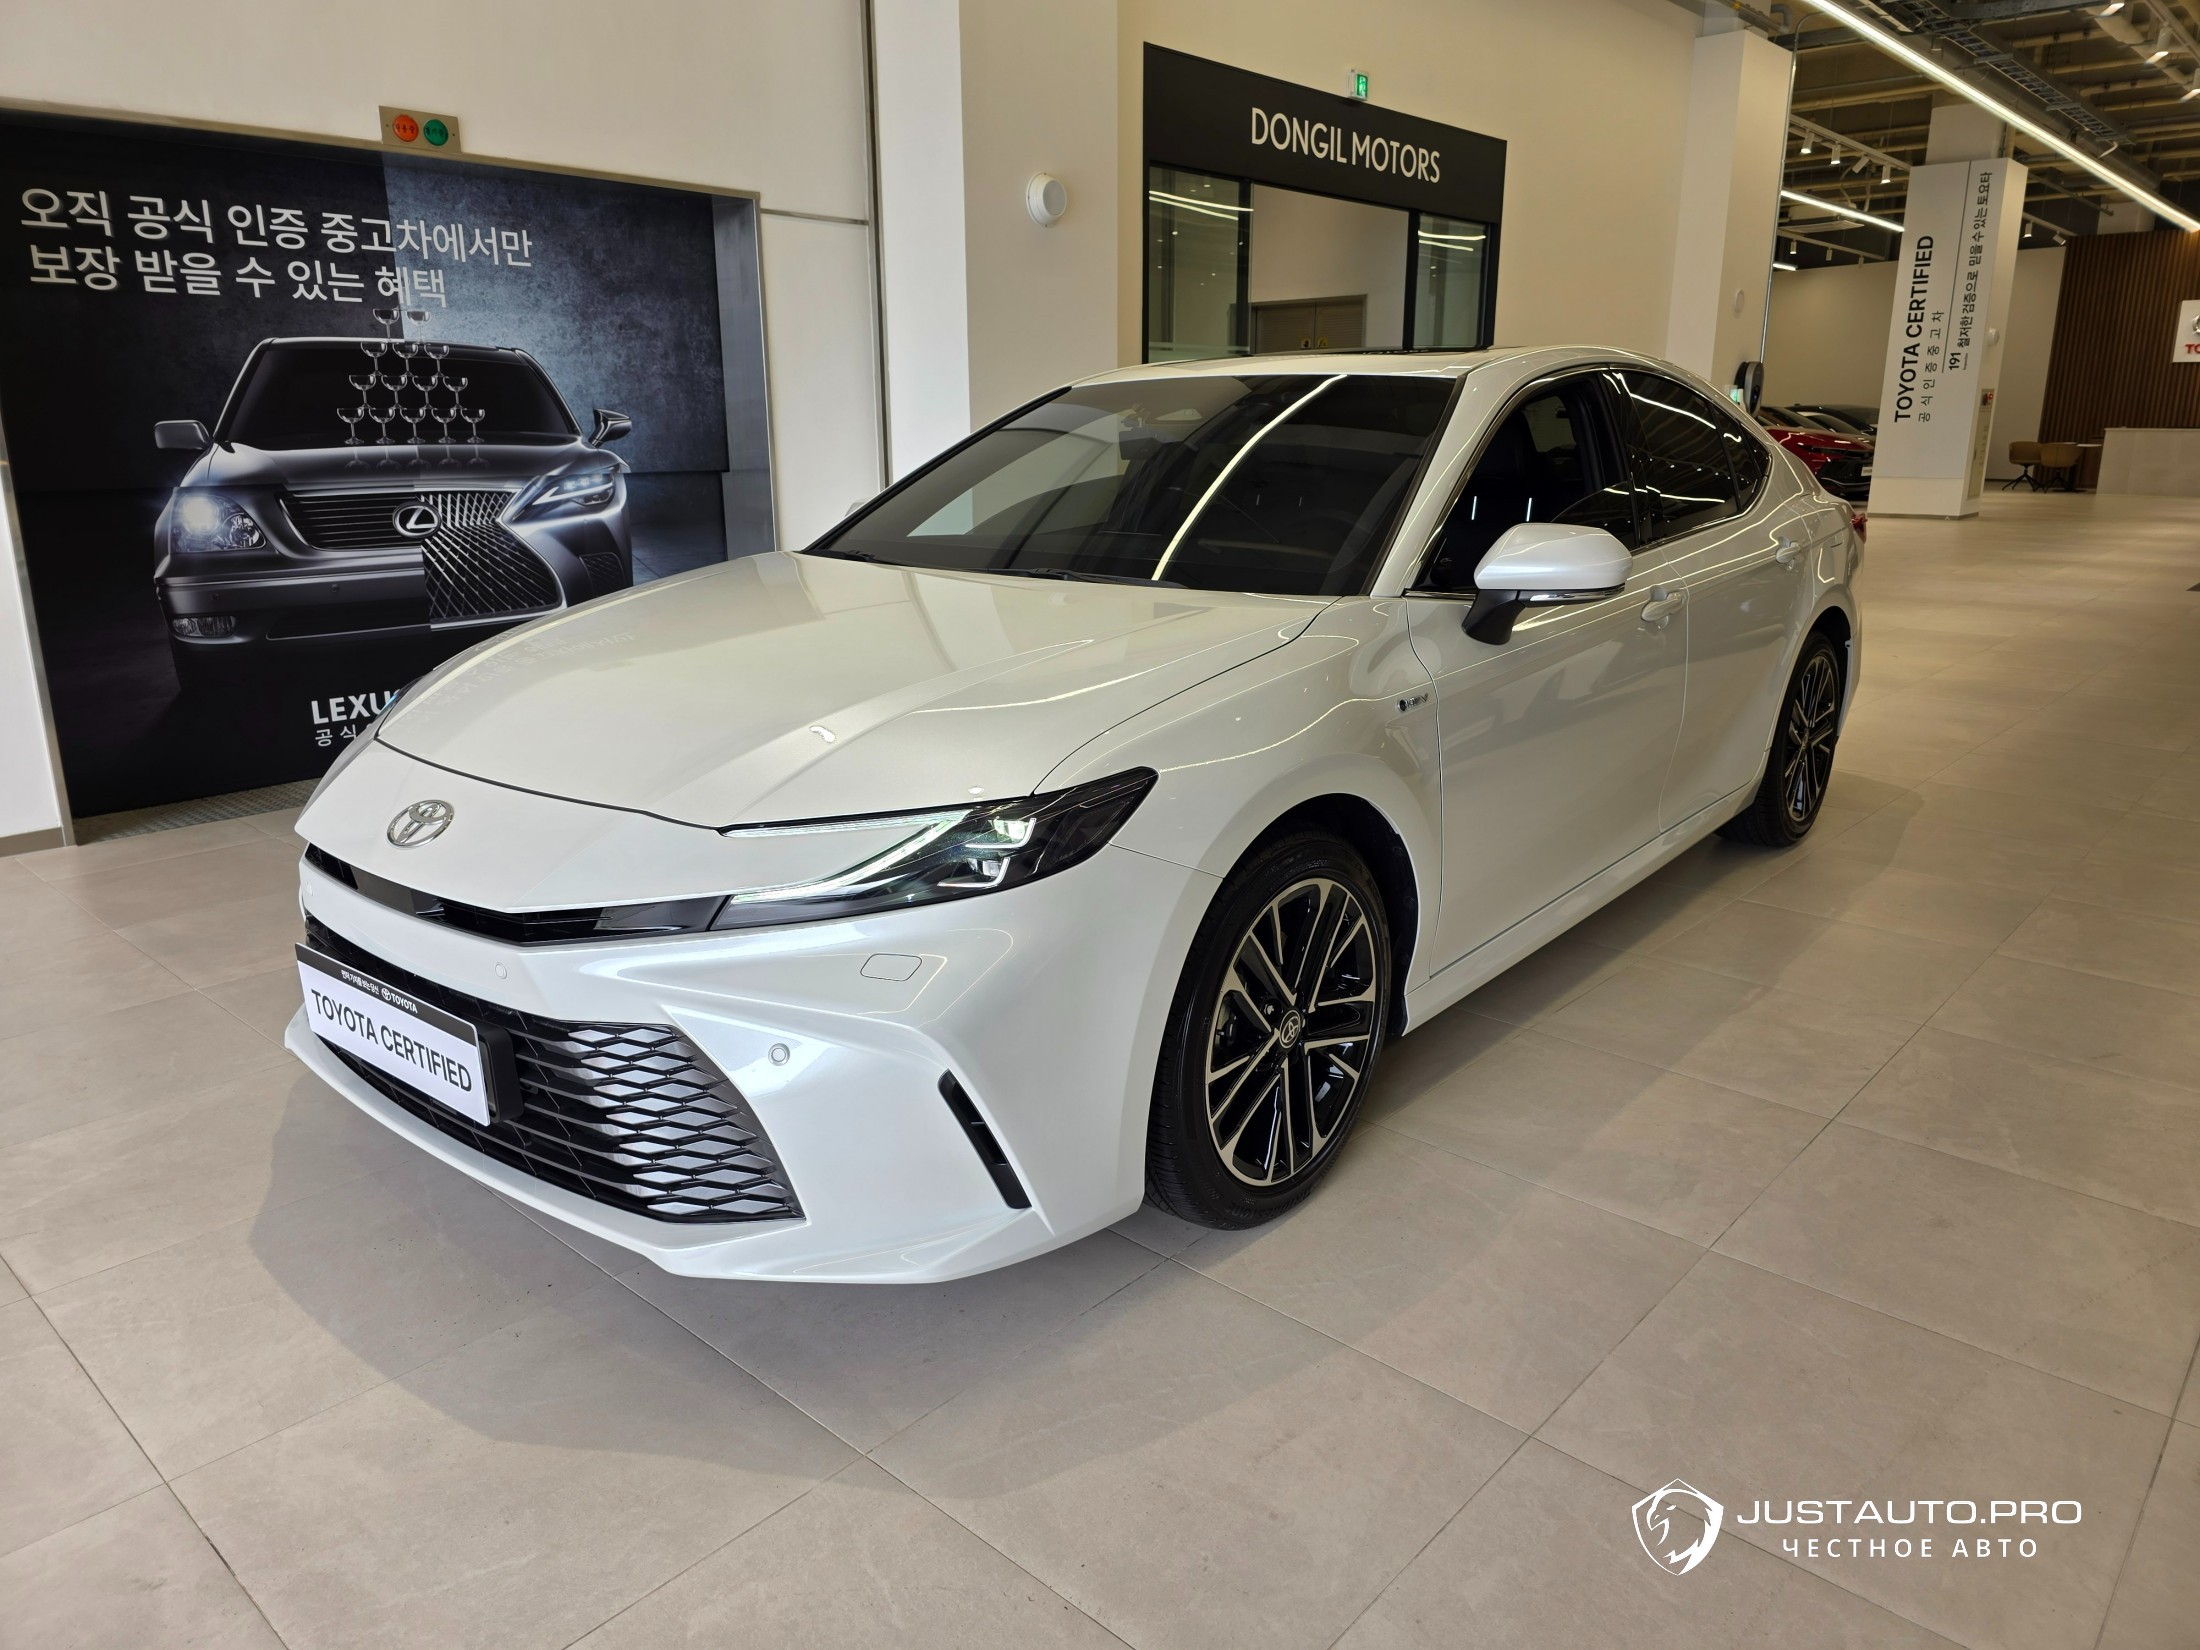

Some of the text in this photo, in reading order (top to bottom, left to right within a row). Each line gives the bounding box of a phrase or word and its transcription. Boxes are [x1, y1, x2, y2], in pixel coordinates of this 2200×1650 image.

[1251, 107, 1441, 184] DONGIL MOTORS
[1977, 171, 1993, 206] 토요타
[21, 188, 533, 267] 오직 공식 인증 중고차에서만
[1972, 231, 1985, 242] 수
[1973, 207, 1988, 229] 있는
[30, 245, 447, 308] 보장 받을 수 있는 혜택
[1962, 269, 1979, 314] 검증으로
[1894, 235, 1934, 423] TOYOTA CERTIFIED
[1948, 352, 1962, 370] 191
[311, 689, 400, 725] LEXU
[390, 993, 418, 1014] TOYOTA
[311, 989, 473, 1093] TOYOTA CERTIFIED
